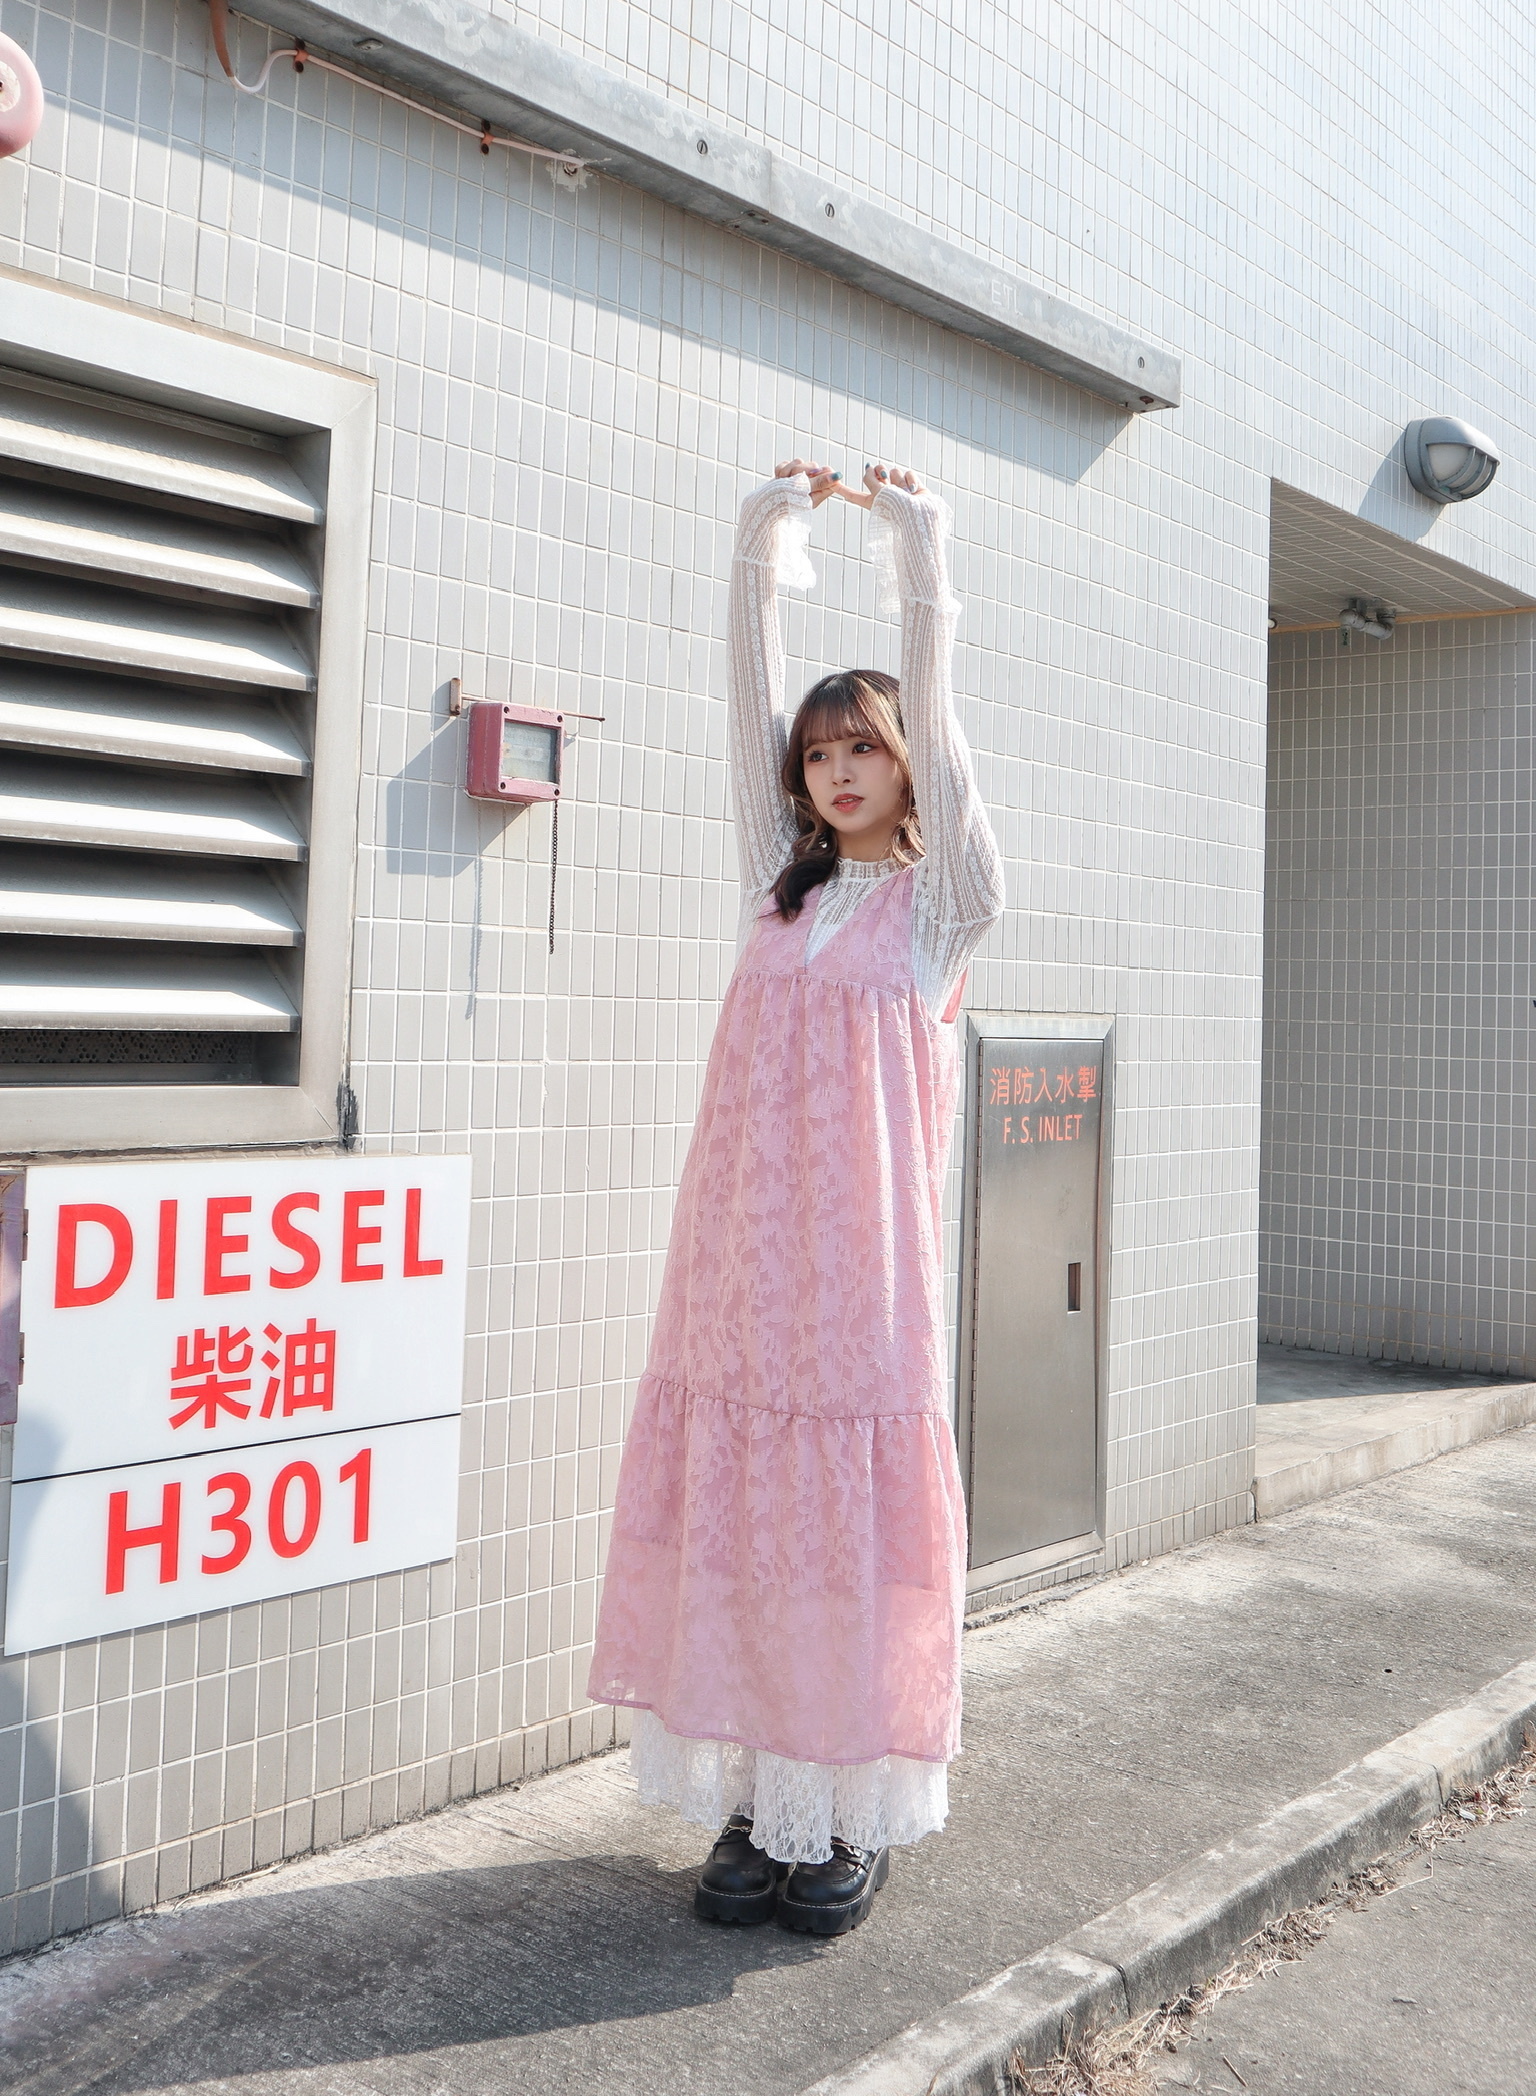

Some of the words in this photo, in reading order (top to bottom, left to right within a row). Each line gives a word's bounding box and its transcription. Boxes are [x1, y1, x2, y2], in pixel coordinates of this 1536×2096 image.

[989, 1065, 1097, 1105] 消防入水掣
[1038, 1114, 1083, 1142] INLET
[54, 1188, 443, 1309] DIESEL
[168, 1317, 337, 1430] 柴油
[105, 1447, 372, 1595] H301
